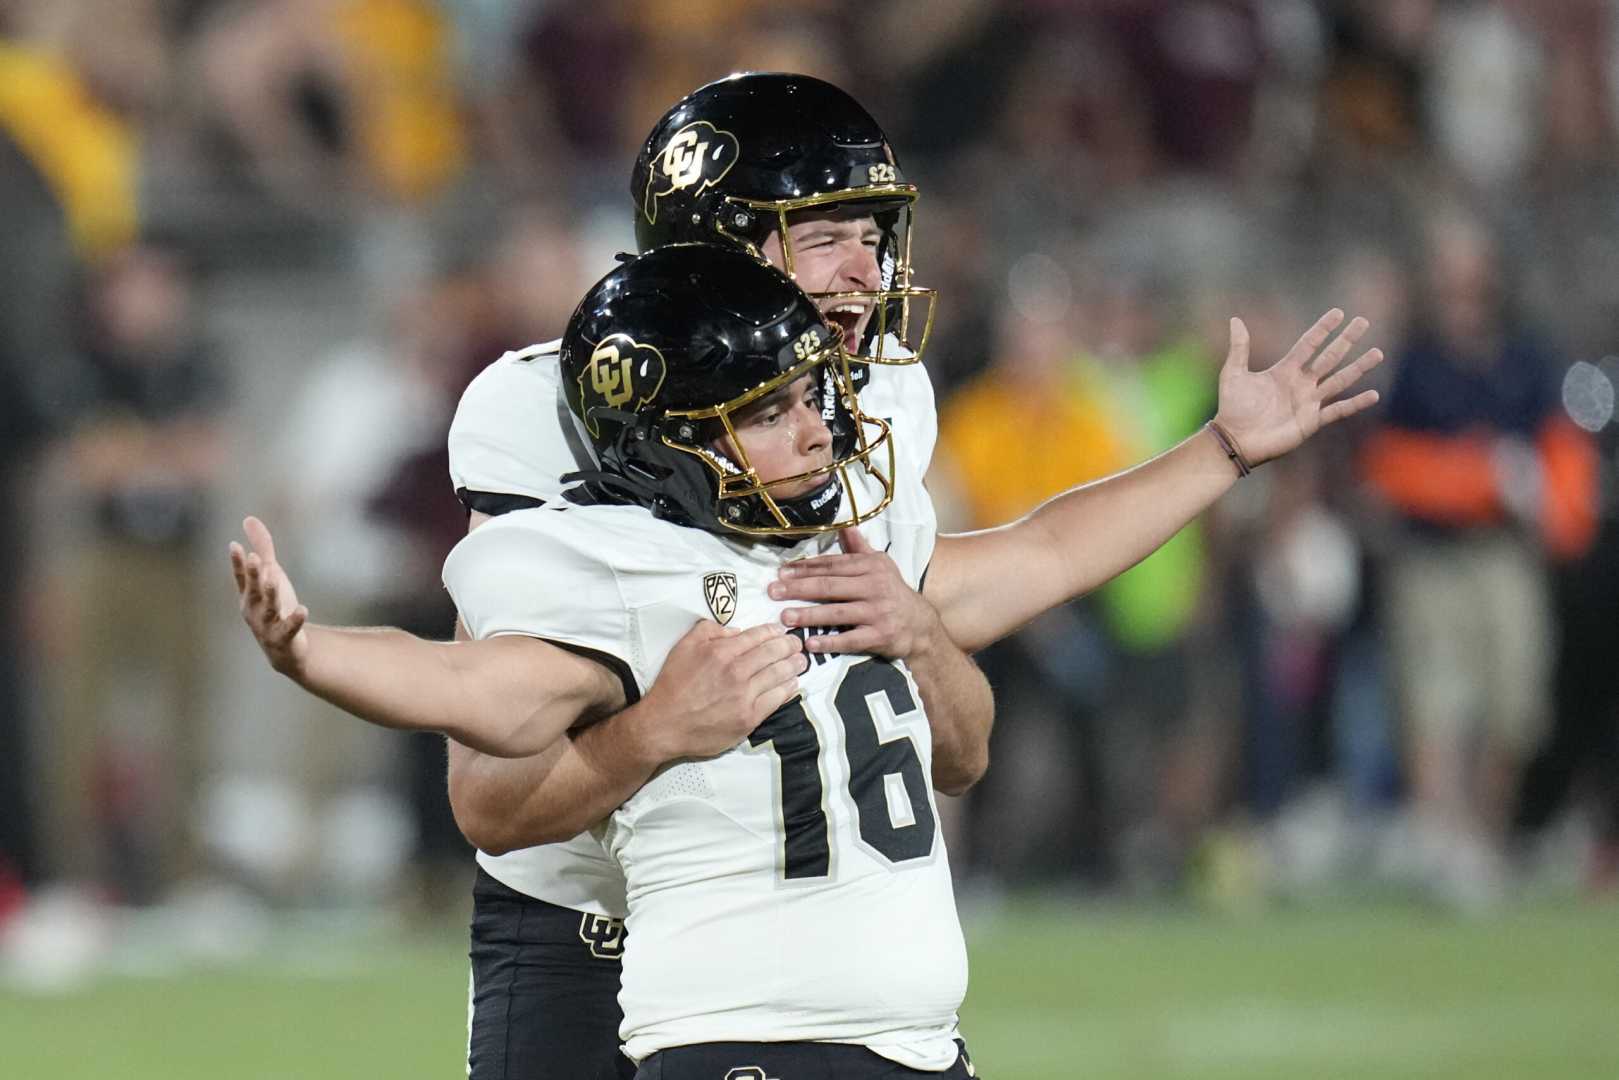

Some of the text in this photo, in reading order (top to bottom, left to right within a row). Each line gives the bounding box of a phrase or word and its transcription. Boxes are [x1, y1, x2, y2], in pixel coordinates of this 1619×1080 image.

[663, 130, 709, 190] CU
[591, 345, 633, 407] CU
[705, 574, 736, 605] PAC
[715, 595, 732, 615] 12
[747, 654, 938, 883] 16
